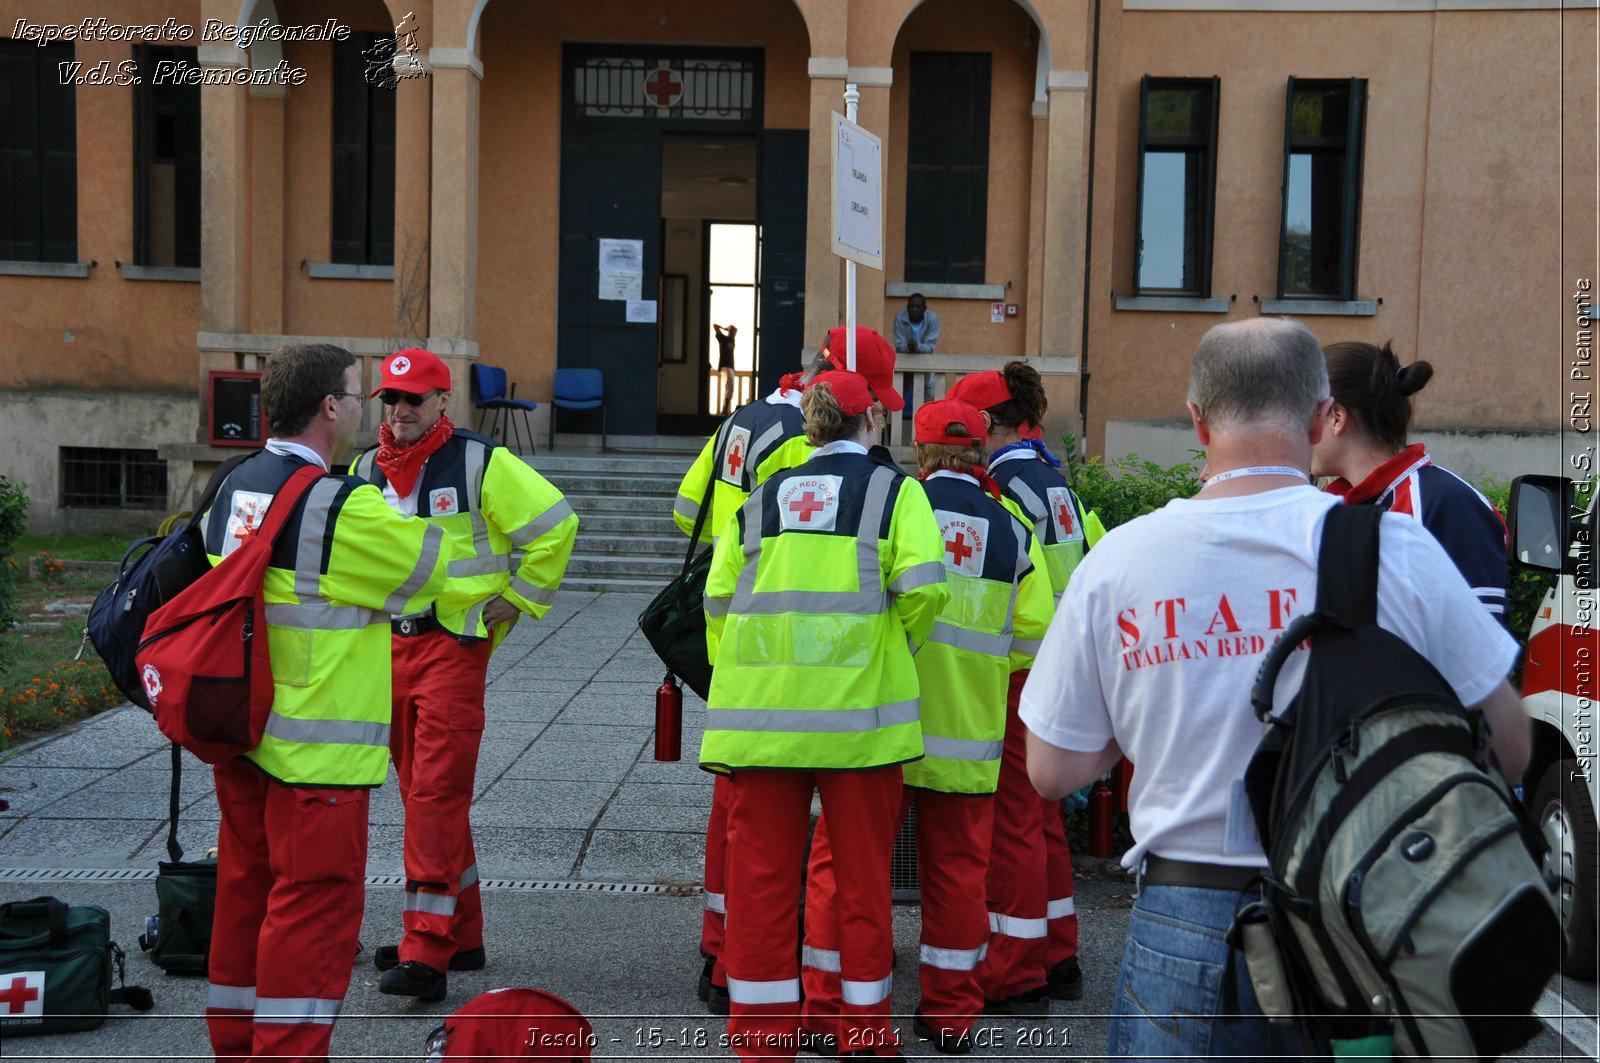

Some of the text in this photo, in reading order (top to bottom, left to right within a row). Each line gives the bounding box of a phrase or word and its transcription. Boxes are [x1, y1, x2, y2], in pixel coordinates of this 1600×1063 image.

[782, 480, 833, 507] IRISH RED CROSS
[950, 520, 966, 528] RED
[966, 526, 983, 553] CROSS
[1122, 638, 1210, 671] ITALIAN
[1217, 634, 1266, 658] RED
